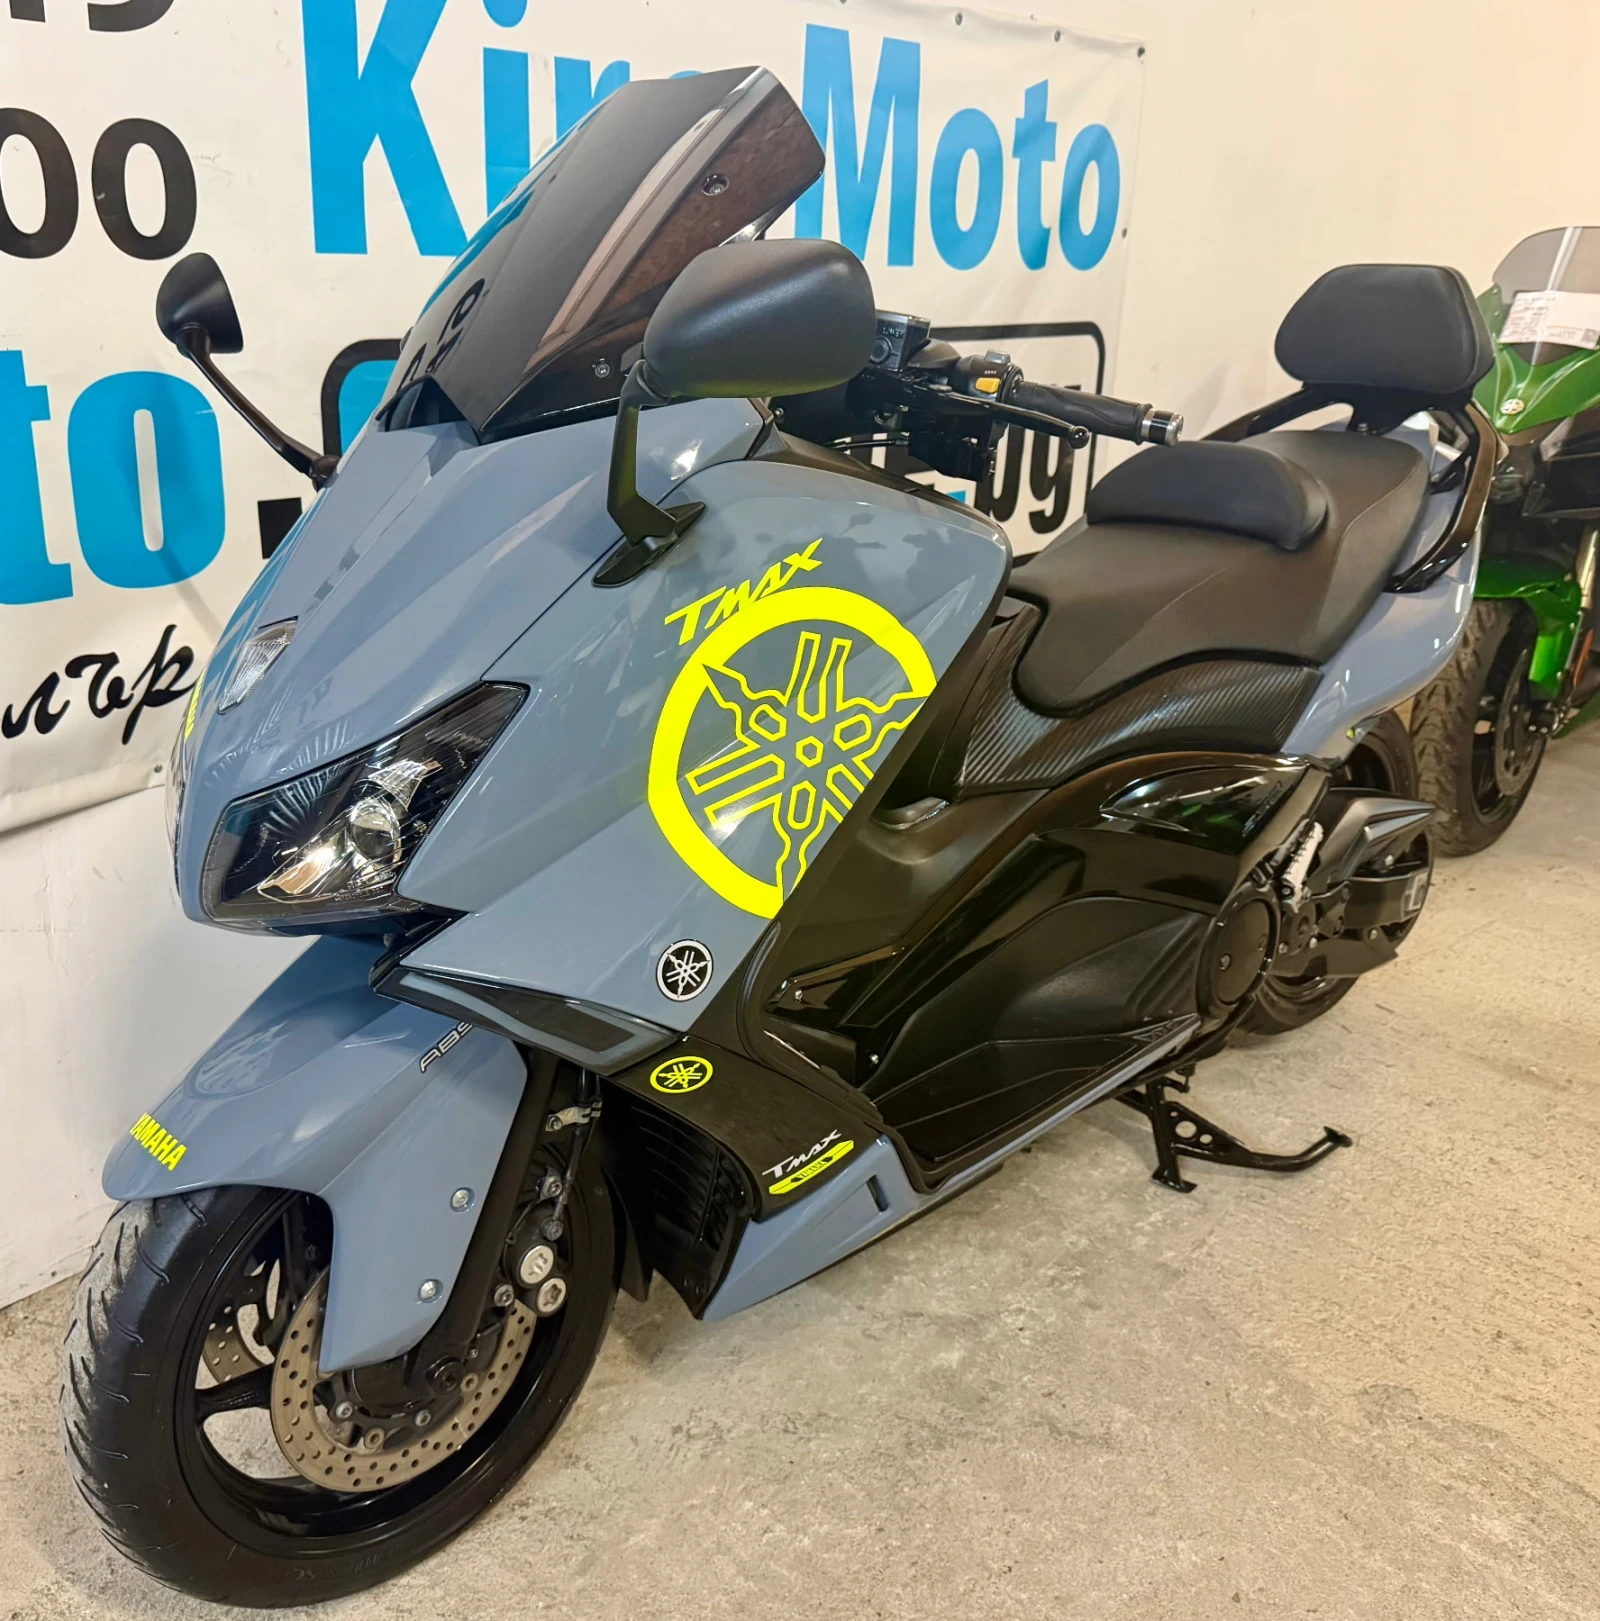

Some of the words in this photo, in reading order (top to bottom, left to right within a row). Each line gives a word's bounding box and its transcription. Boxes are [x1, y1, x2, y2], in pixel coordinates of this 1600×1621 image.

[794, 23, 1121, 271] Moto
[664, 537, 824, 646] TMAX
[419, 1021, 474, 1073] ABS
[129, 1111, 188, 1171] YAMAHA
[762, 1128, 842, 1179] TMAX
